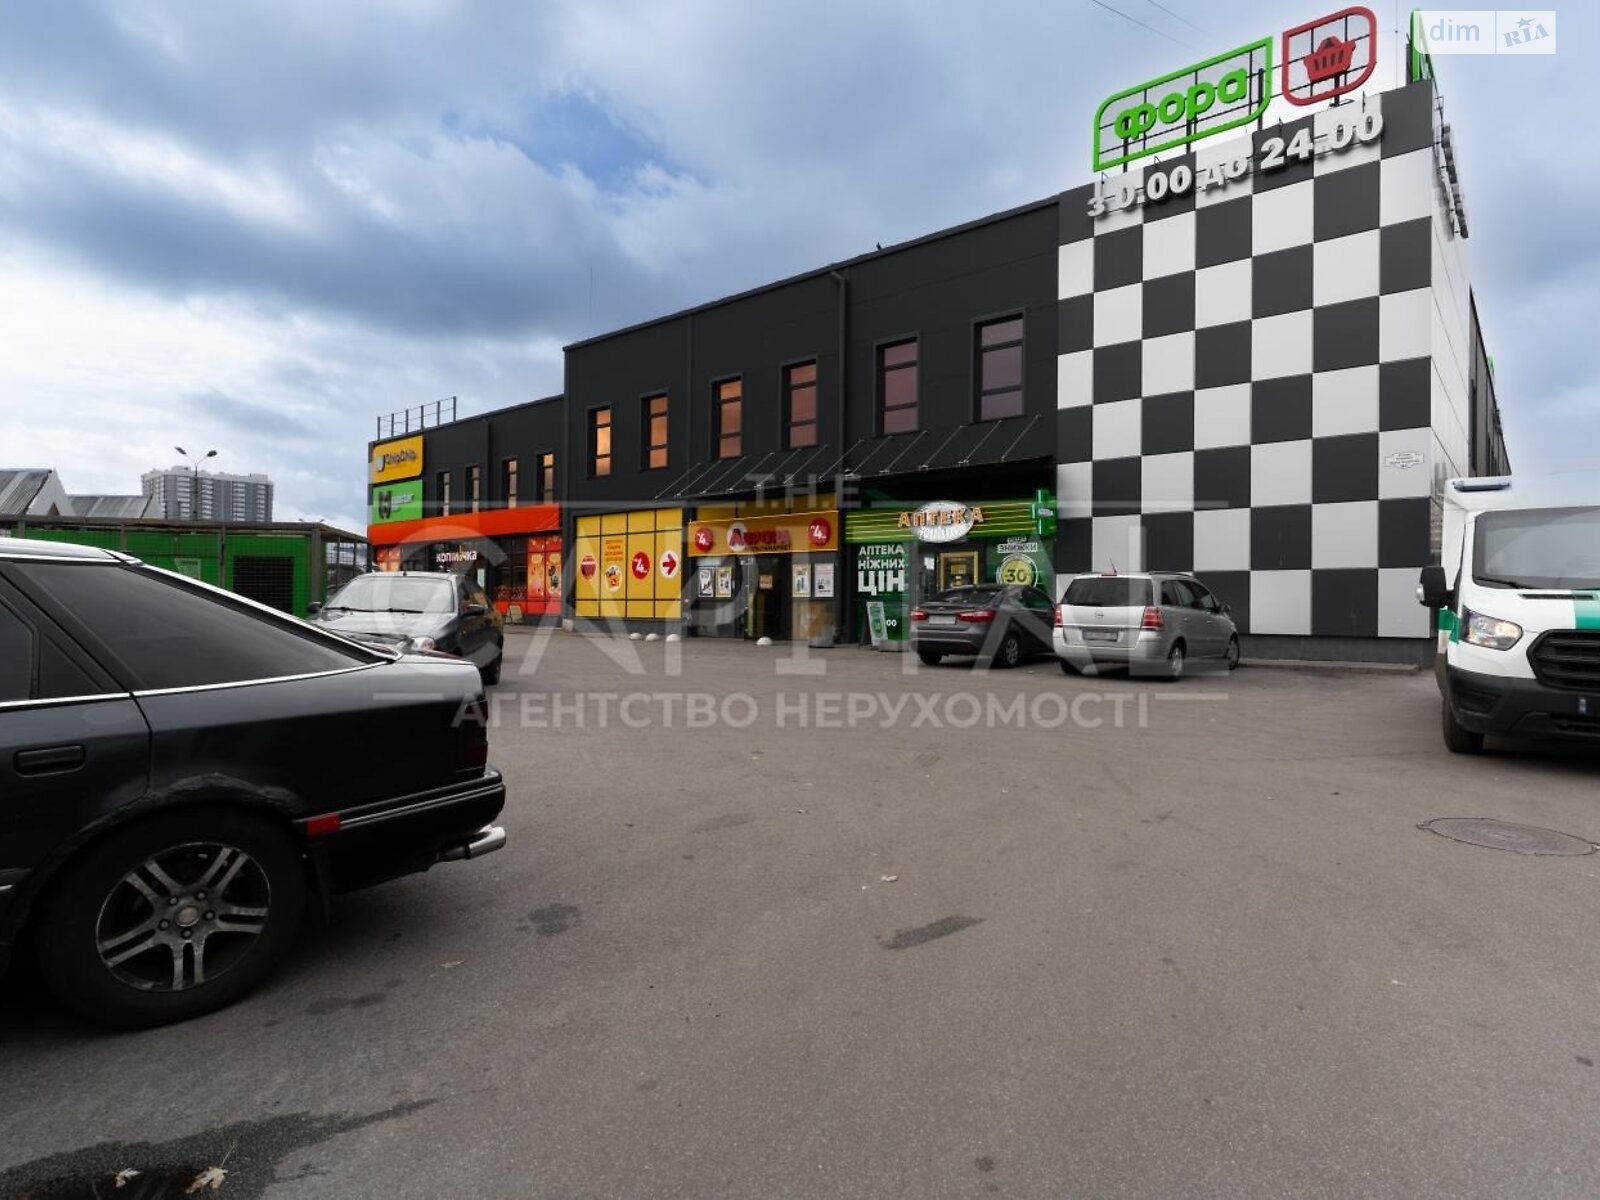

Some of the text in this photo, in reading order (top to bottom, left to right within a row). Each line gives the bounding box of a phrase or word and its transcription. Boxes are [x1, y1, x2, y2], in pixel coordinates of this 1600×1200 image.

[1114, 67, 1249, 140] фора
[1197, 156, 1249, 191] до
[1260, 108, 1384, 169] 24.00
[897, 507, 985, 528] АПТЕКА
[859, 544, 905, 556] АПТЕКА
[858, 570, 905, 596] ЦІН
